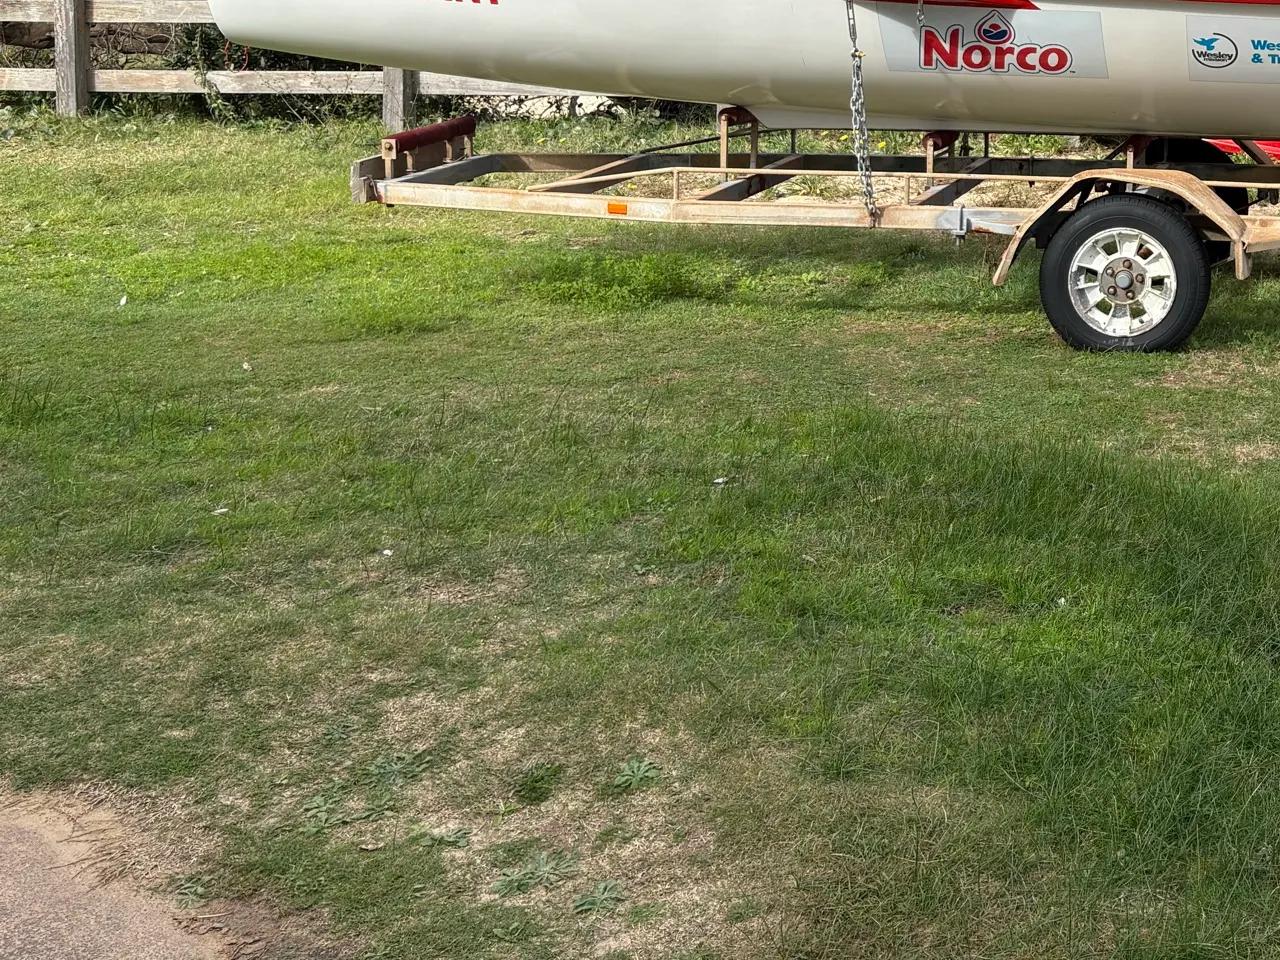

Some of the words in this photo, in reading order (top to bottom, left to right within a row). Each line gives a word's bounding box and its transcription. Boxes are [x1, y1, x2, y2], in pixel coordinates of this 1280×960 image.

[922, 27, 1070, 73] Norco
[1196, 50, 1234, 61] Wesley
[1251, 53, 1264, 64] &
